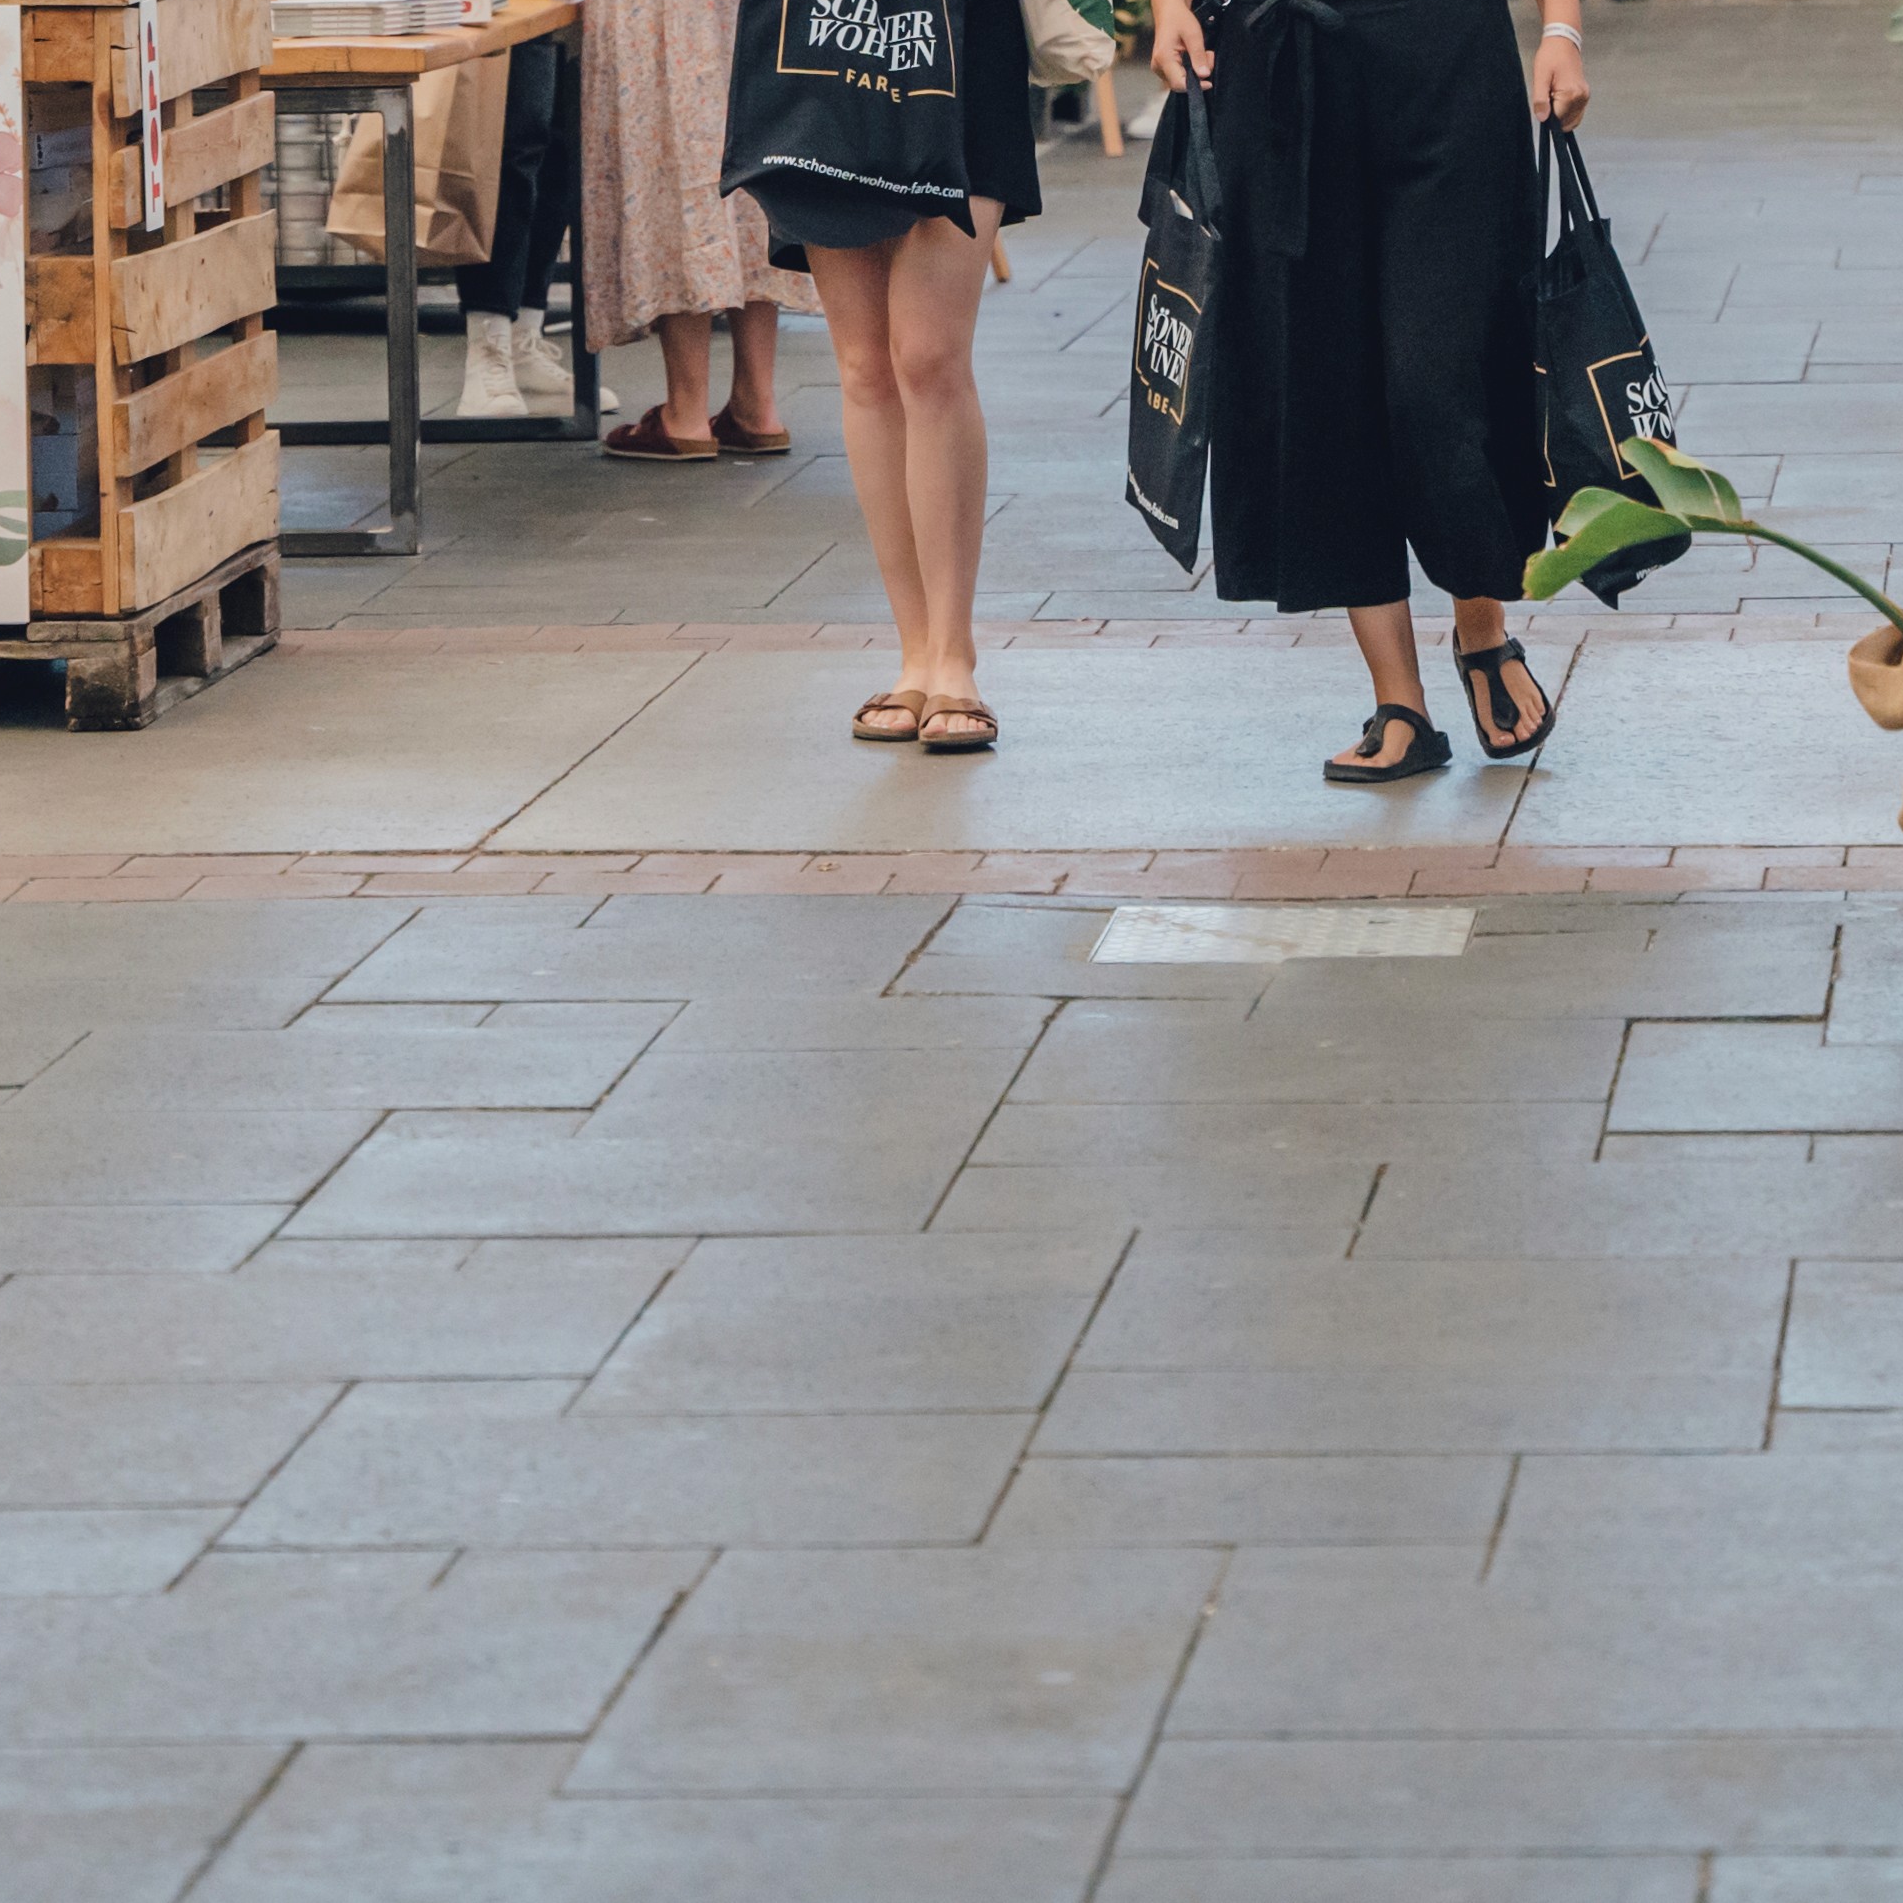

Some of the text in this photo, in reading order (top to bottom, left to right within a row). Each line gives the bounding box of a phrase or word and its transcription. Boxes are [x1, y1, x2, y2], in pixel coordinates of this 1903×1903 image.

[808, 18, 937, 72] WOHEN
[846, 68, 902, 103] FARE
[146, 20, 162, 213] TOPP
[762, 154, 964, 199] www.schoener-wohnen-farbe.com
